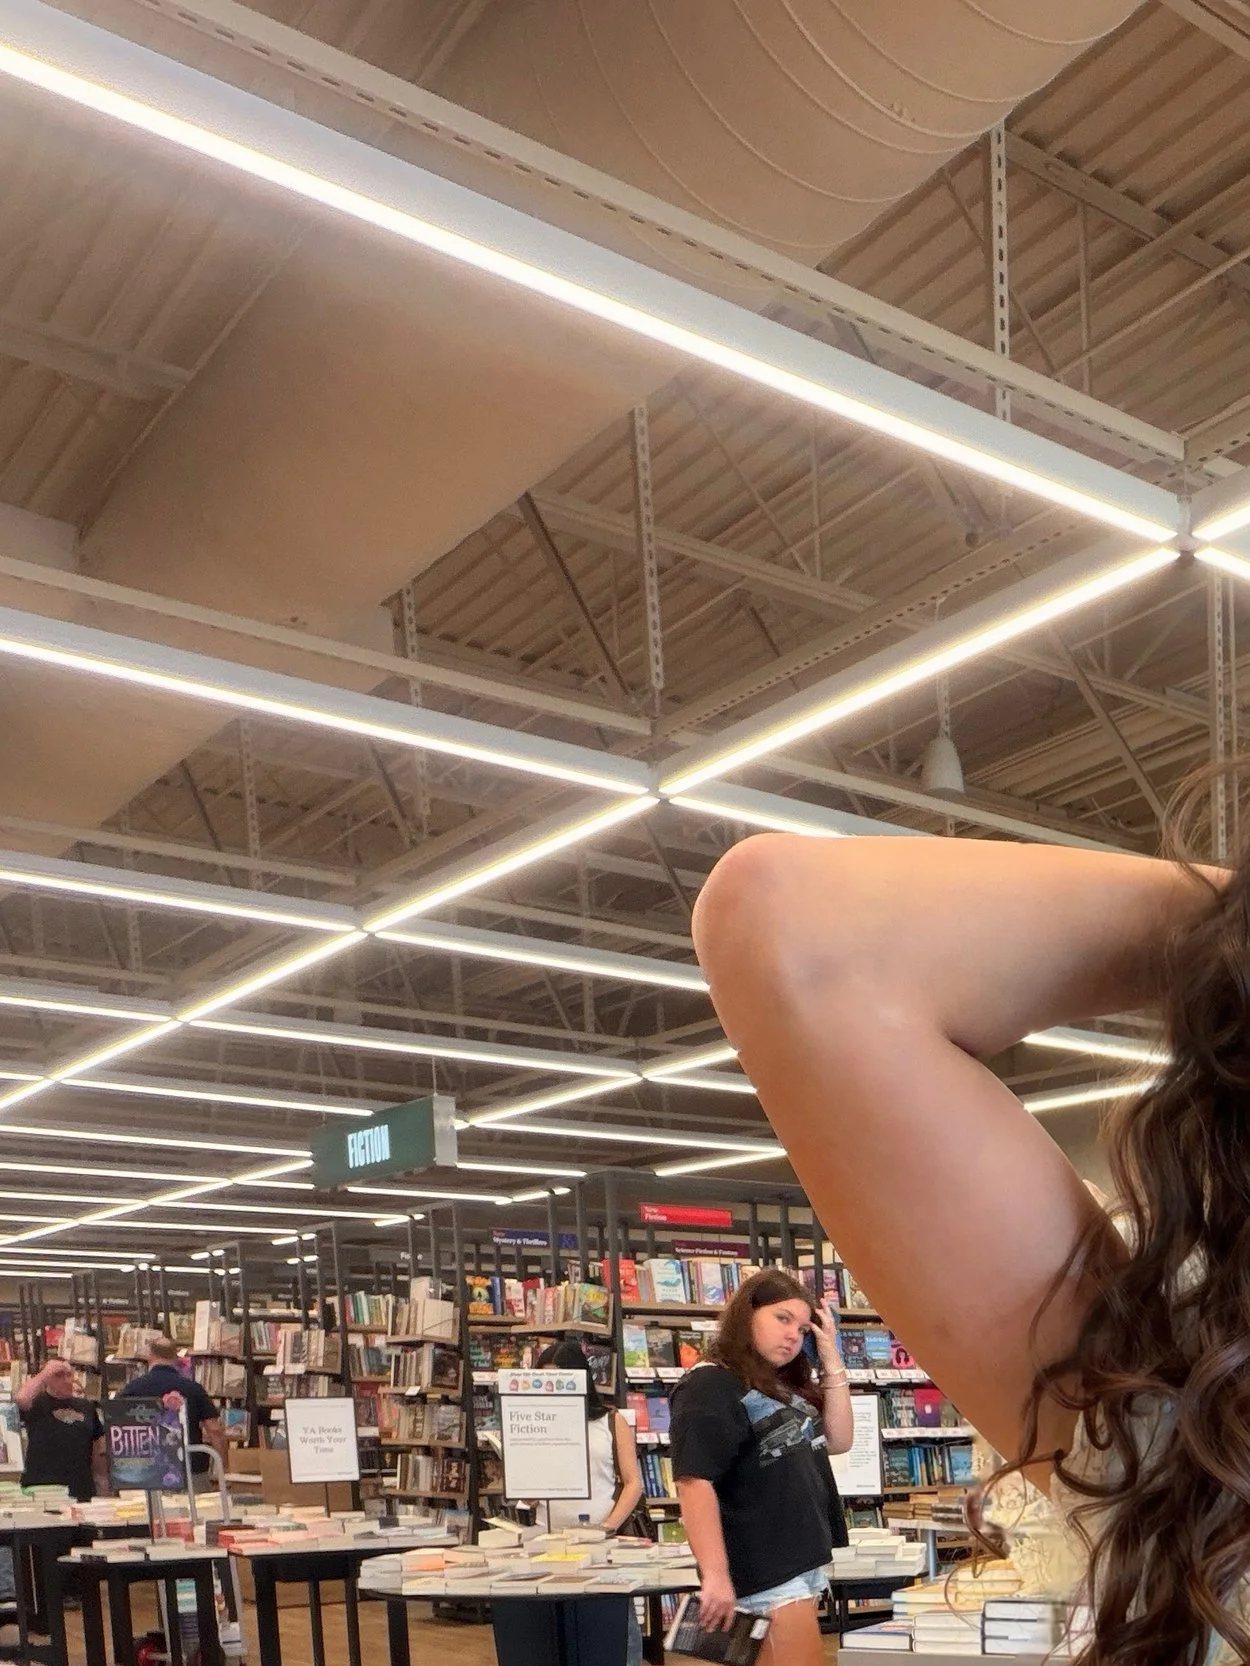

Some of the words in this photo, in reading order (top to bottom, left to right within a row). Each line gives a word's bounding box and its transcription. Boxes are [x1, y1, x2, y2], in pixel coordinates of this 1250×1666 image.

[347, 1124, 391, 1169] FICTION
[509, 1411, 532, 1421] Five
[534, 1411, 557, 1421] Star
[510, 1423, 547, 1434] Fiction
